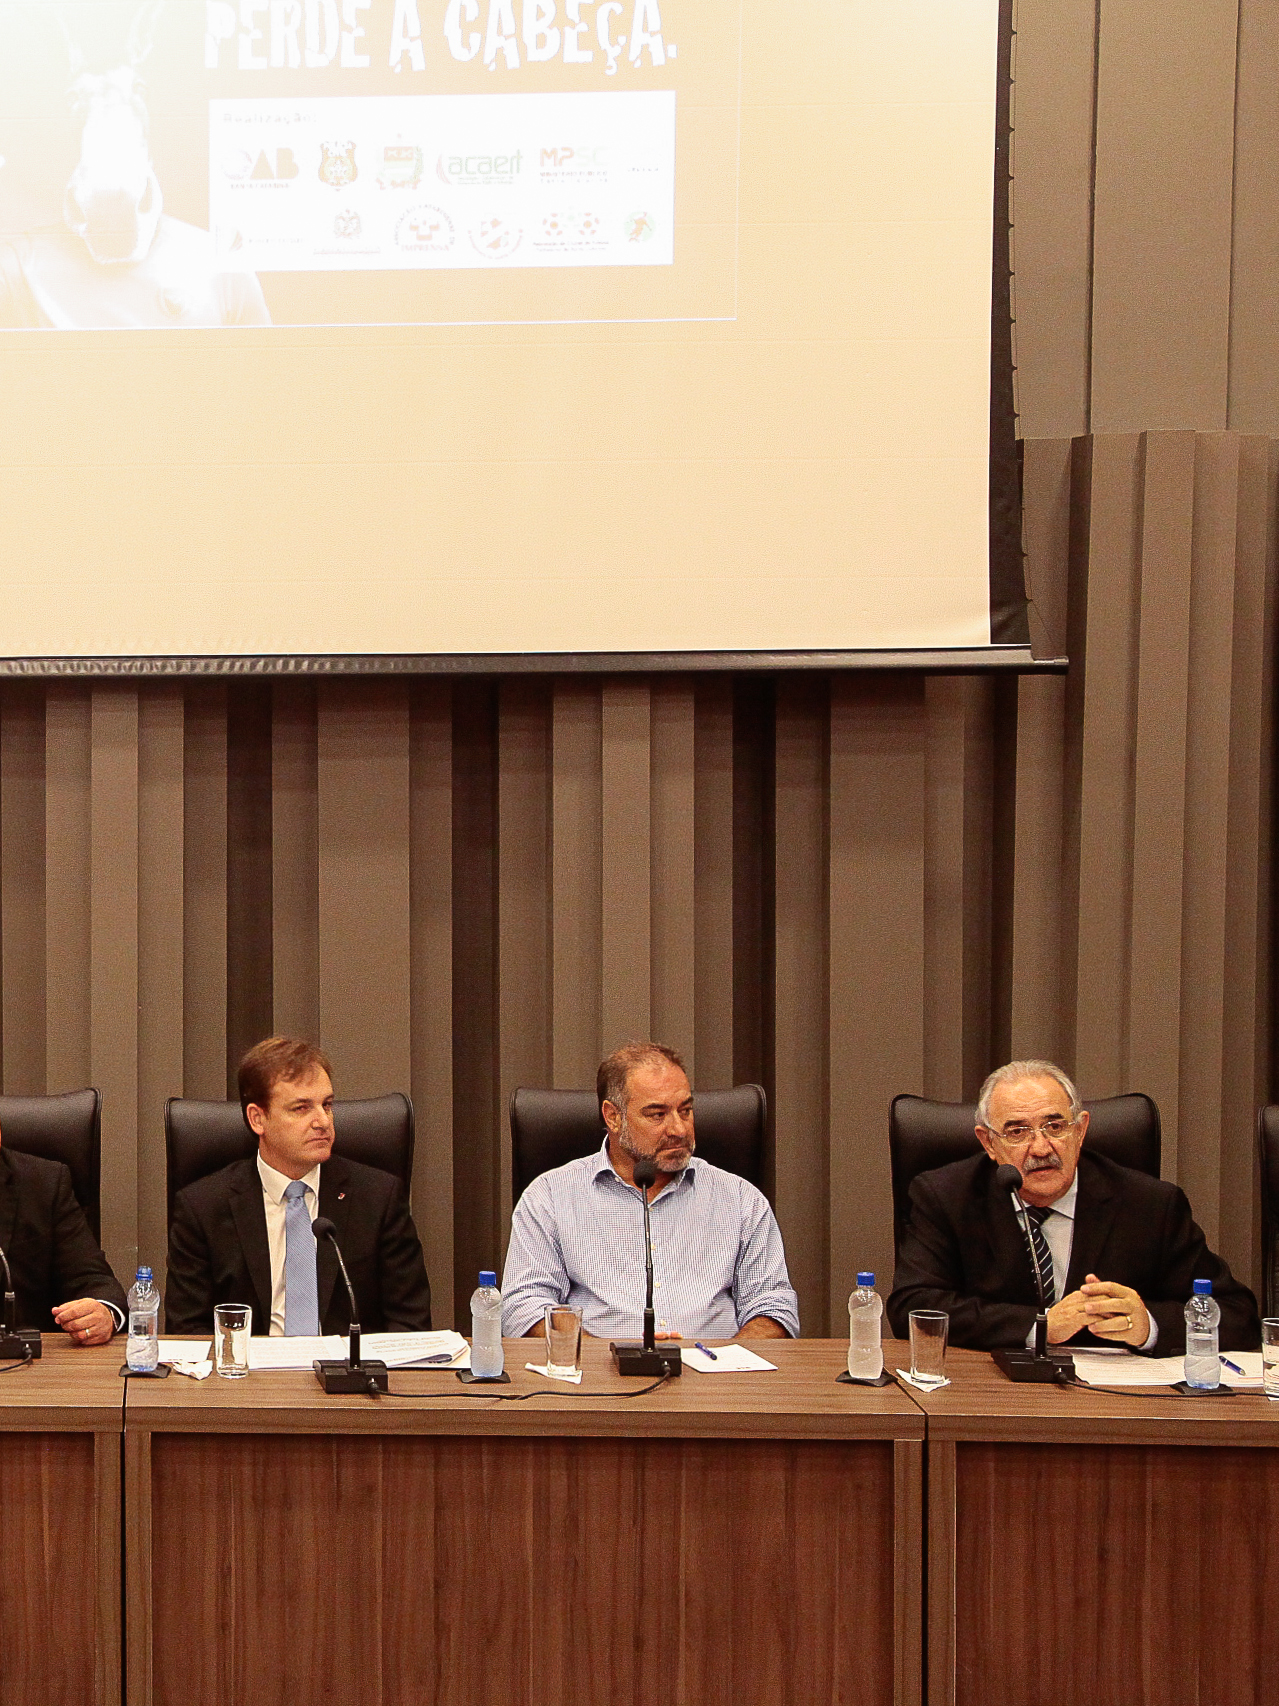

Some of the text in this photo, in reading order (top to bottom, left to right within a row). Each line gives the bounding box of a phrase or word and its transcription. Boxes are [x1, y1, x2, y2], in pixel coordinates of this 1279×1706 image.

[204, 0, 678, 75] PERDE A CABEÇA.
[448, 149, 524, 175] acaert
[539, 146, 610, 168] MPSC
